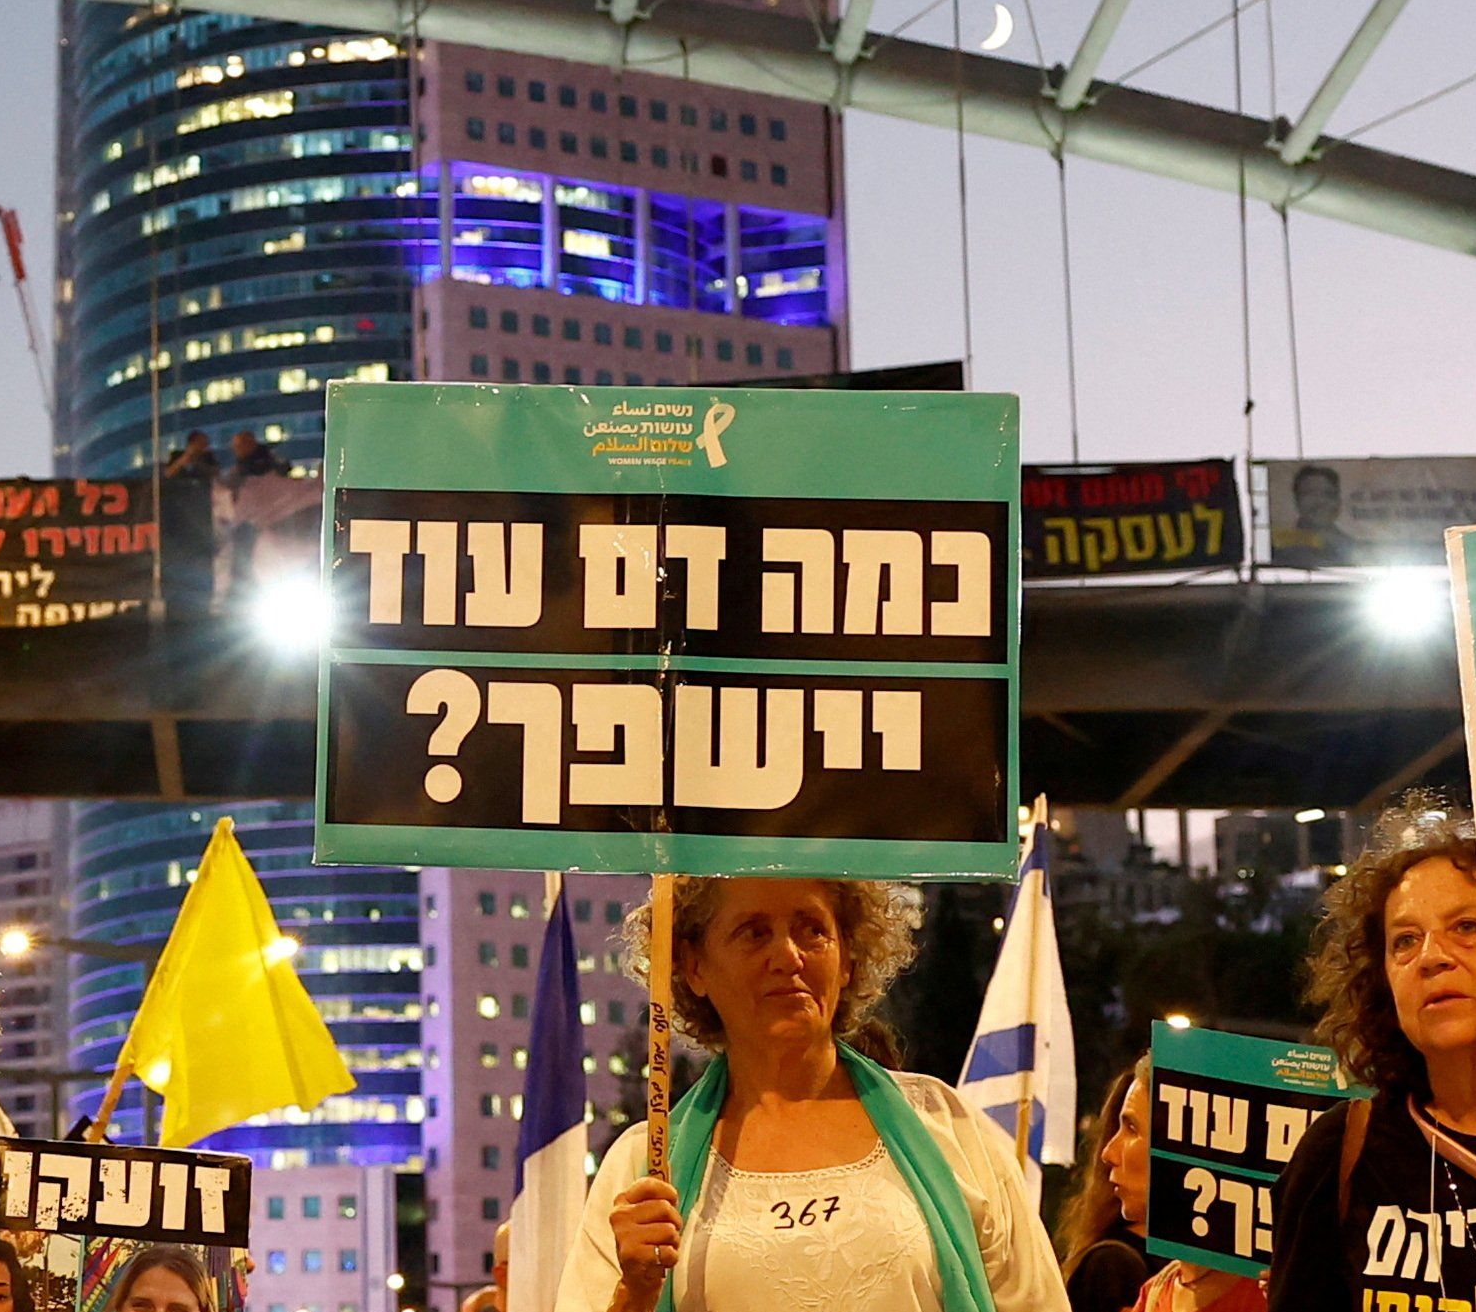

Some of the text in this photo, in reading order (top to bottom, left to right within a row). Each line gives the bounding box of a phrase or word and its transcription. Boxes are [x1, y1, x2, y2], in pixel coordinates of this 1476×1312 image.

[612, 401, 651, 416] نساء
[655, 404, 693, 417] נשים
[583, 421, 638, 437] يصنعن
[640, 422, 693, 435] עושות
[592, 437, 647, 456] السلام
[651, 438, 693, 453] שלום
[76, 479, 128, 515] כל
[1044, 503, 1224, 571] לעסקה
[349, 519, 991, 635] כמה דם עוד
[406, 669, 922, 824] יישפך?
[1159, 1083, 1249, 1154] עוד
[771, 1196, 841, 1229] 367
